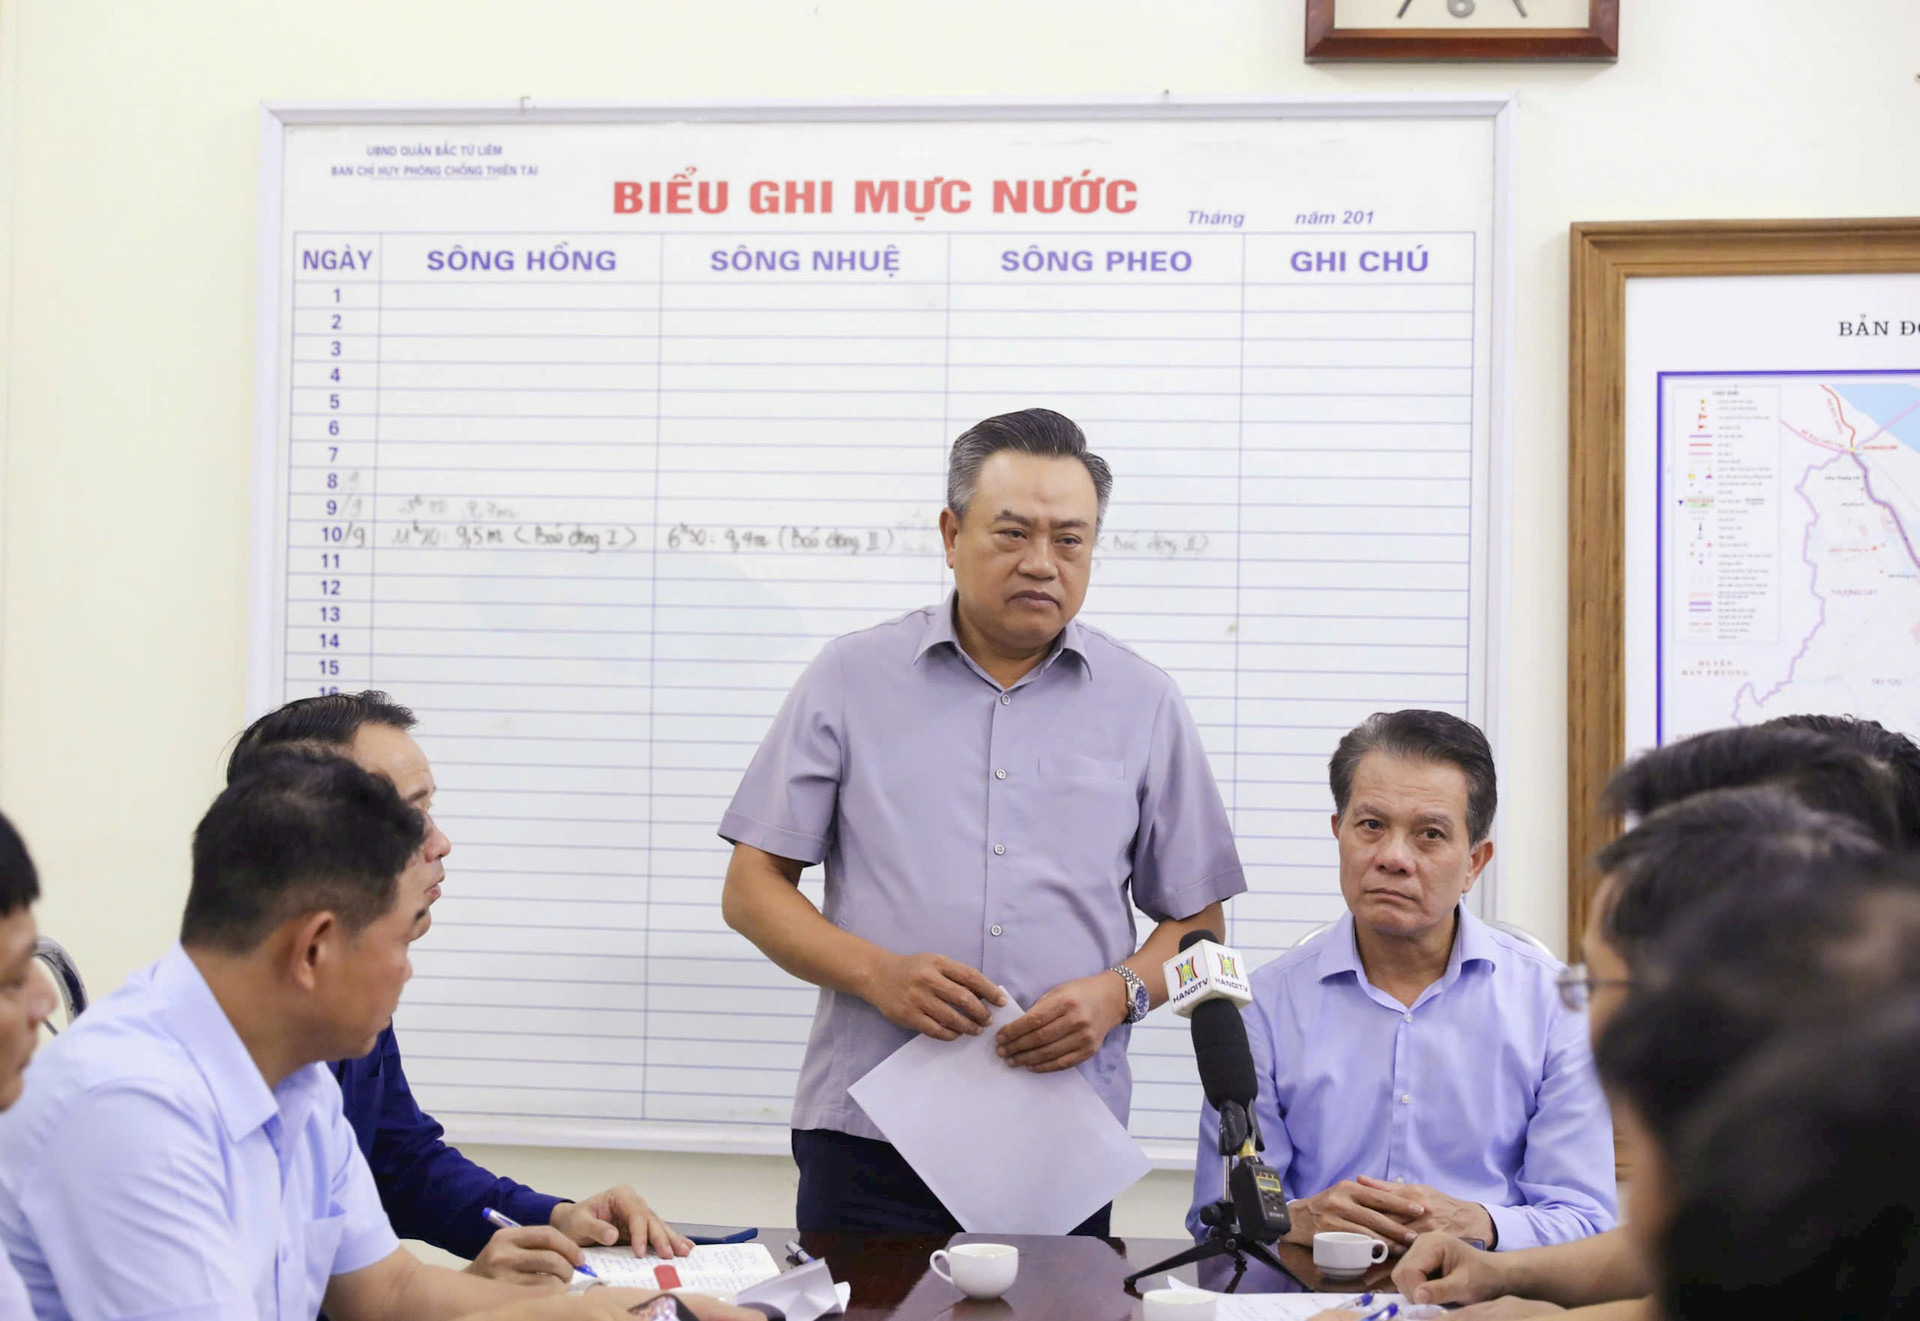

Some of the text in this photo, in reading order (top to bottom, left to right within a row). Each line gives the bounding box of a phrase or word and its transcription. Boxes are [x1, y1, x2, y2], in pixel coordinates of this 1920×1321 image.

[330, 166, 354, 177] BAN
[377, 166, 400, 177] HUY
[613, 166, 1138, 221] BIỂU GHI MỰC NƯỚC
[1188, 209, 1245, 228] Tháng
[1295, 210, 1374, 225] năm 201
[302, 244, 373, 272] NGÀY
[426, 240, 617, 272] SÔNG HỒNG
[710, 243, 900, 278] SÔNG NHUỆ
[1000, 244, 1193, 273] SÔNG PHEO
[1289, 244, 1429, 273] GHI CHÚ
[333, 288, 341, 303] 1
[331, 314, 342, 330] 2
[1838, 313, 1920, 337] BẢN Đ
[330, 341, 342, 356] 3
[329, 367, 342, 383] 4
[329, 394, 341, 410] 5
[327, 420, 340, 436] 6
[328, 447, 339, 463] 7
[326, 473, 339, 489] 8
[321, 553, 340, 569] 11
[320, 580, 342, 596] 12
[320, 606, 341, 622] 13
[319, 633, 340, 649] 14
[319, 660, 340, 676] 15
[1173, 977, 1209, 1004] HANOITV
[1214, 977, 1250, 993] HANOITV
